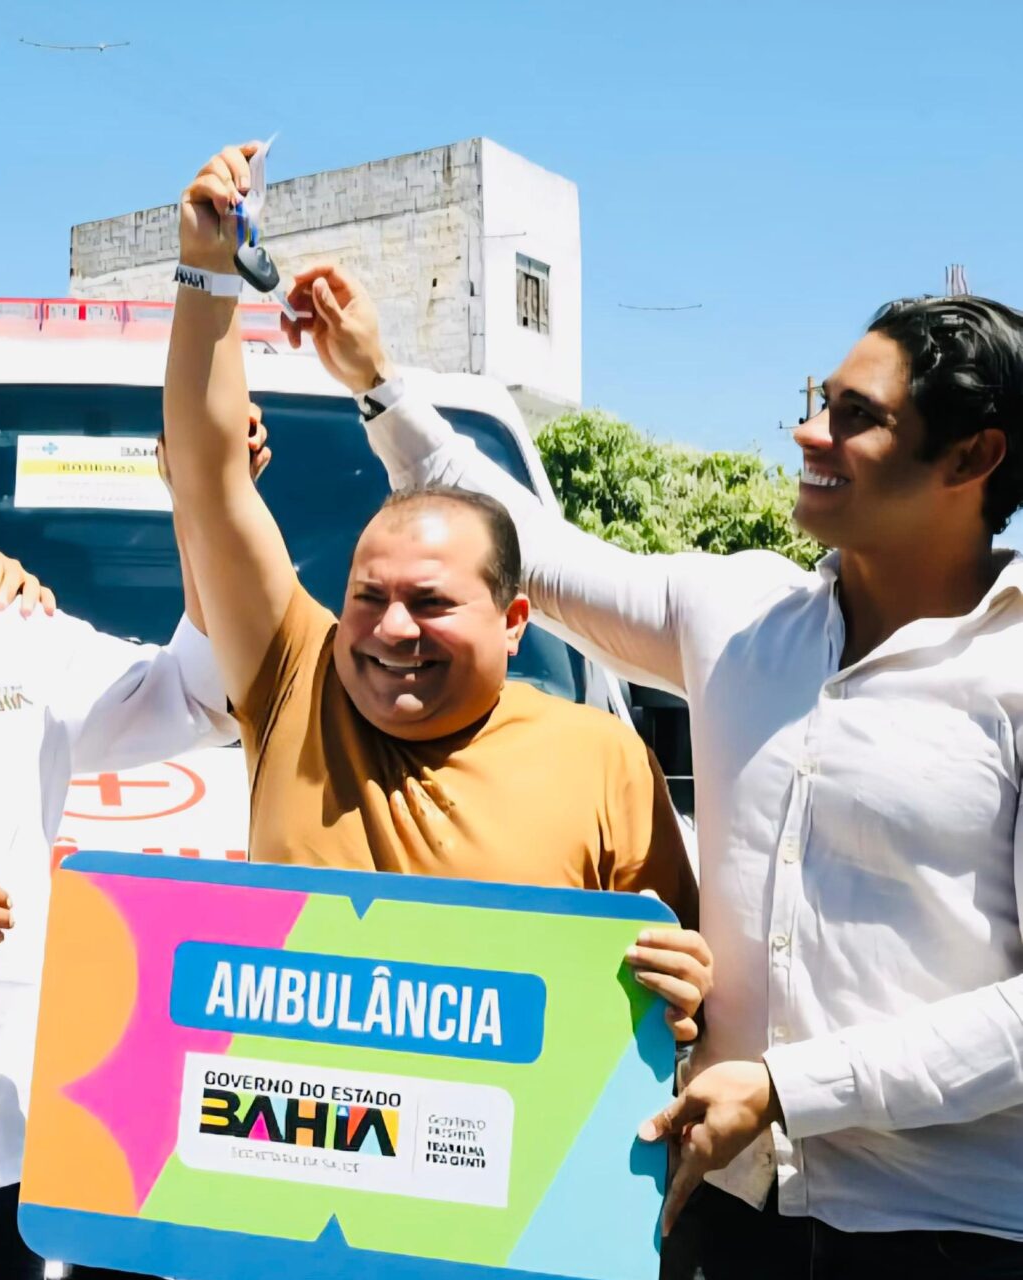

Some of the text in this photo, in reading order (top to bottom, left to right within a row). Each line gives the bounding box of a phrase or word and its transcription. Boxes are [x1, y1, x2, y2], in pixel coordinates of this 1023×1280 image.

[205, 961, 503, 1046] AMBULÂNCIA
[199, 1088, 399, 1157] BAHIA
[204, 1070, 402, 1108] GOVERNO DO ESTADO
